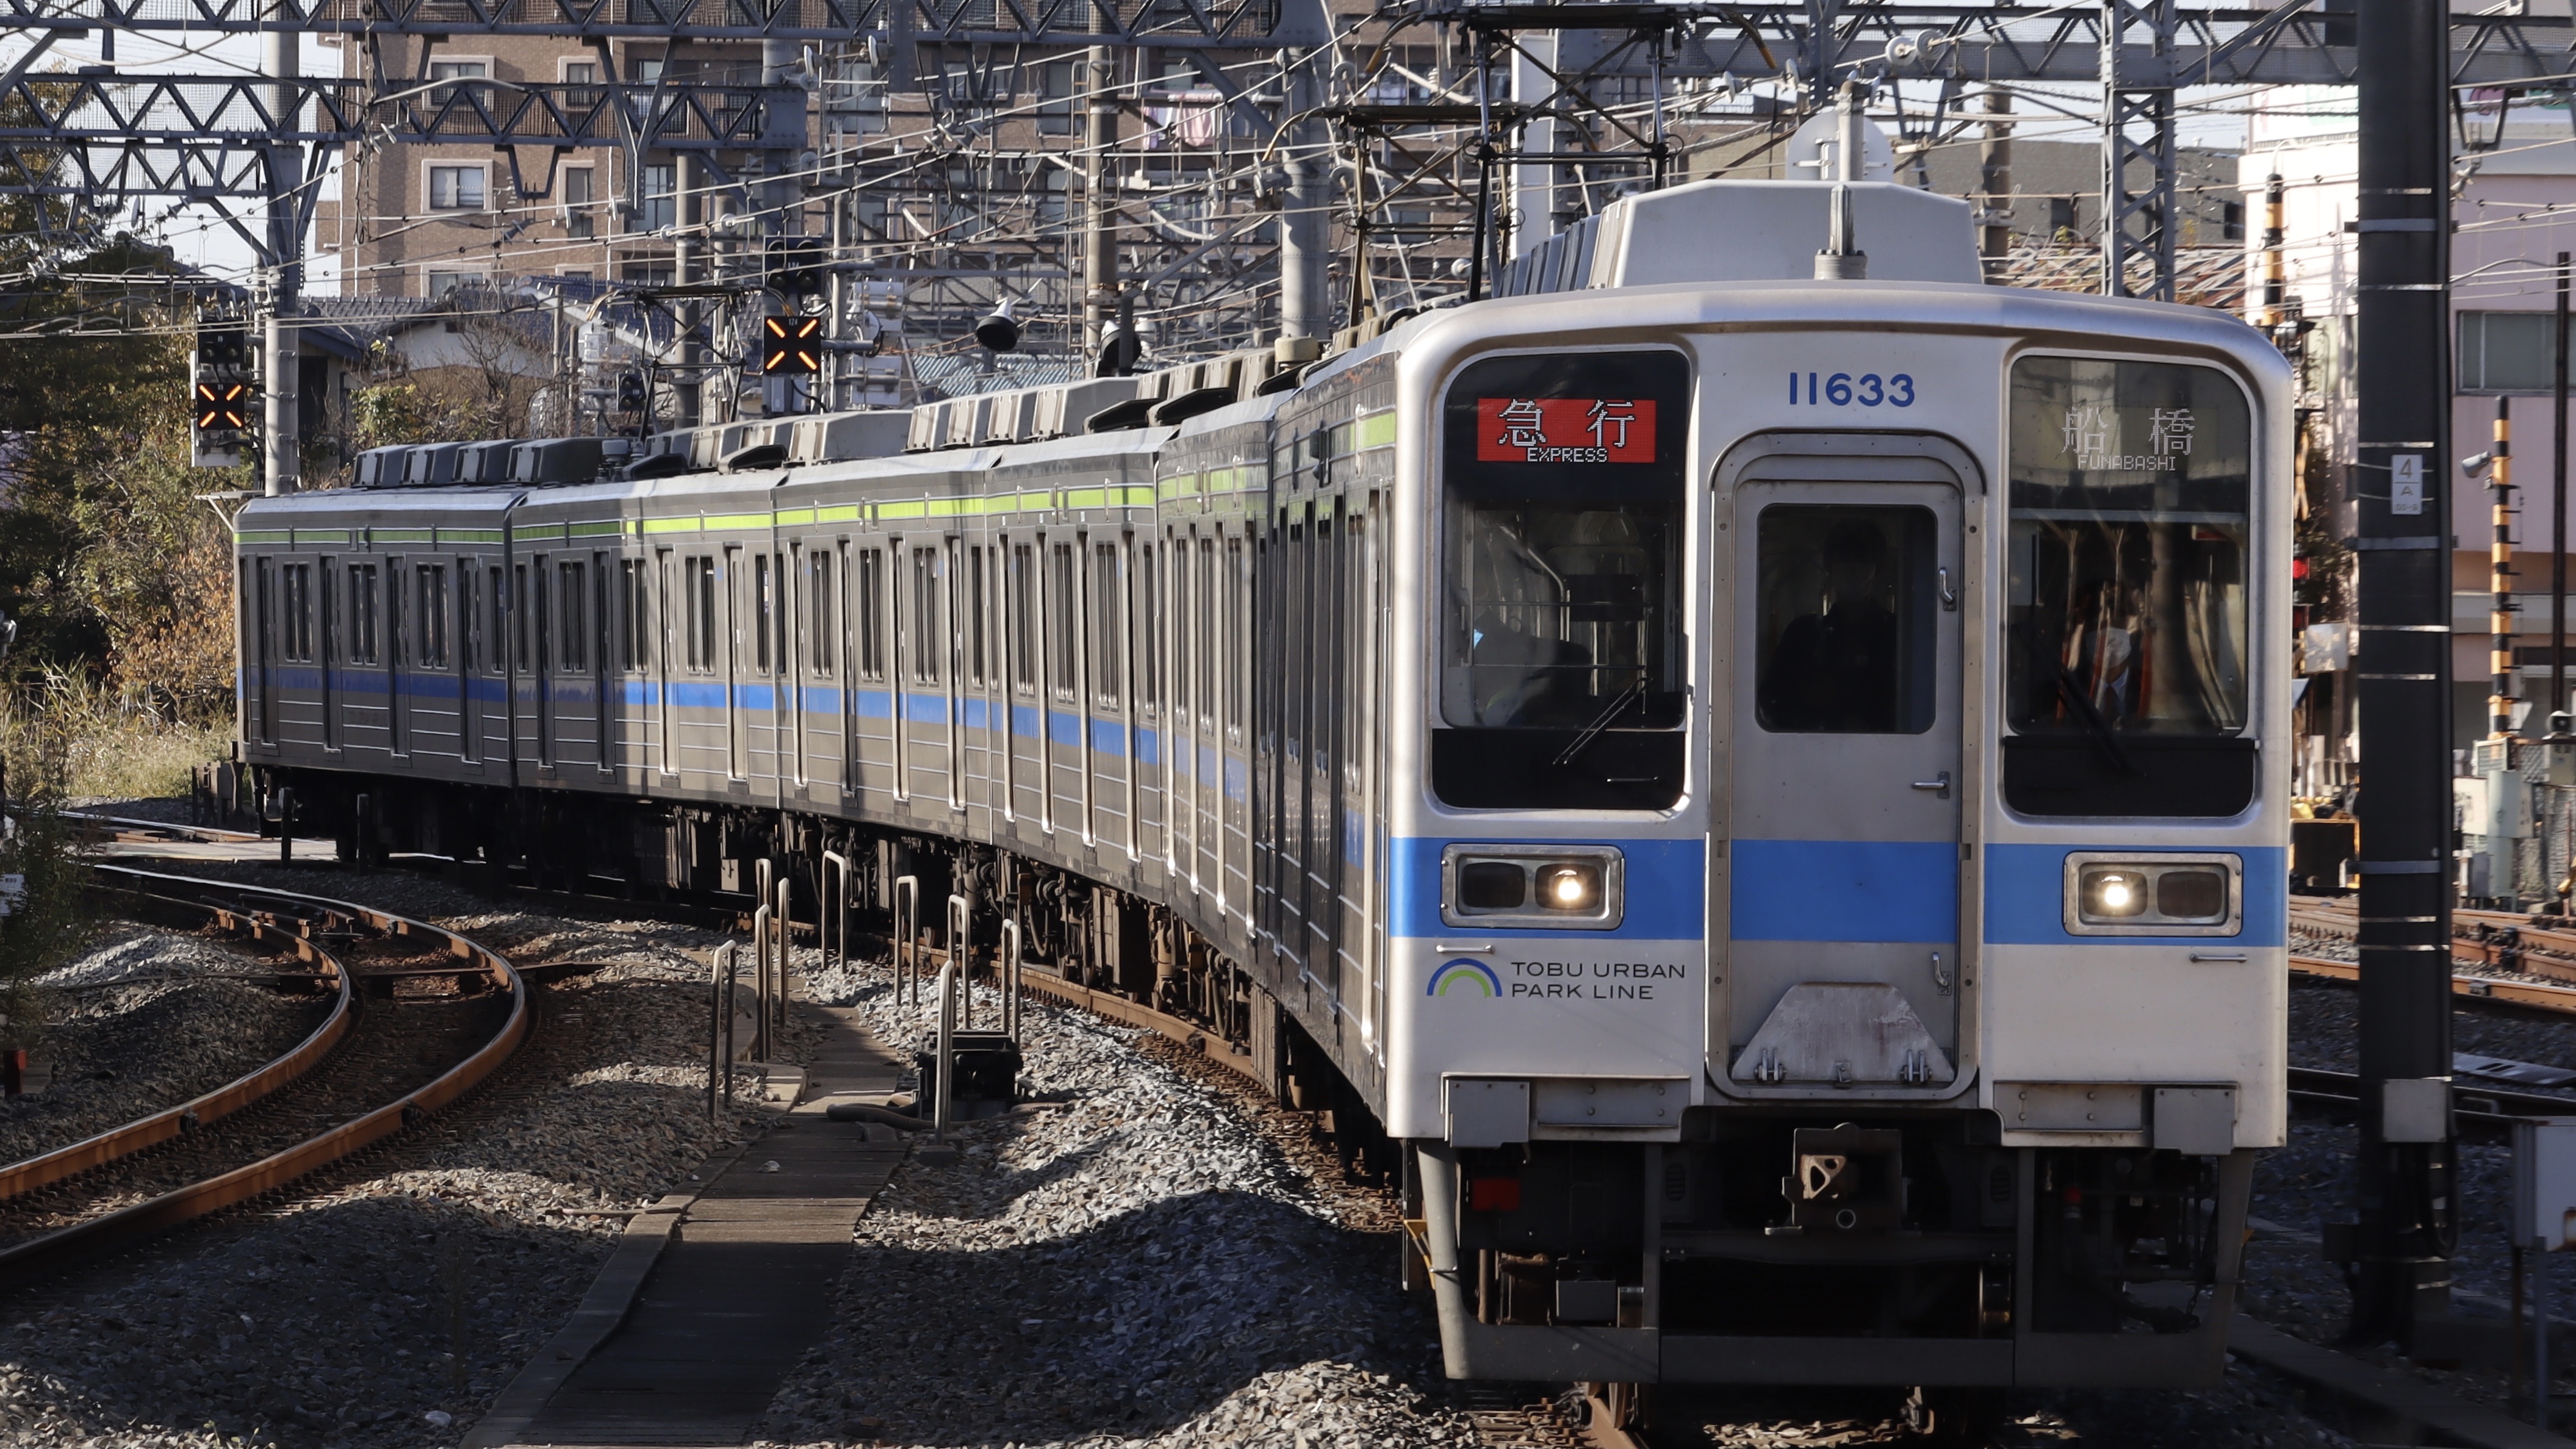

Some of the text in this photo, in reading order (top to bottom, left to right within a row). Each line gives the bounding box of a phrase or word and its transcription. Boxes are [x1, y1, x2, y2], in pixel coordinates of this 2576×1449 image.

[1790, 372, 1915, 408] 11633
[1498, 398, 1635, 447] 急行
[2061, 406, 2195, 456] 船橋
[1527, 447, 1608, 462] EXPRESS
[2078, 455, 2176, 471] FUNABASHI
[2398, 458, 2414, 479] 4
[2400, 486, 2414, 496] A
[1511, 962, 1685, 979] TOBU URBAN
[1511, 983, 1653, 1000] PARK LINE
